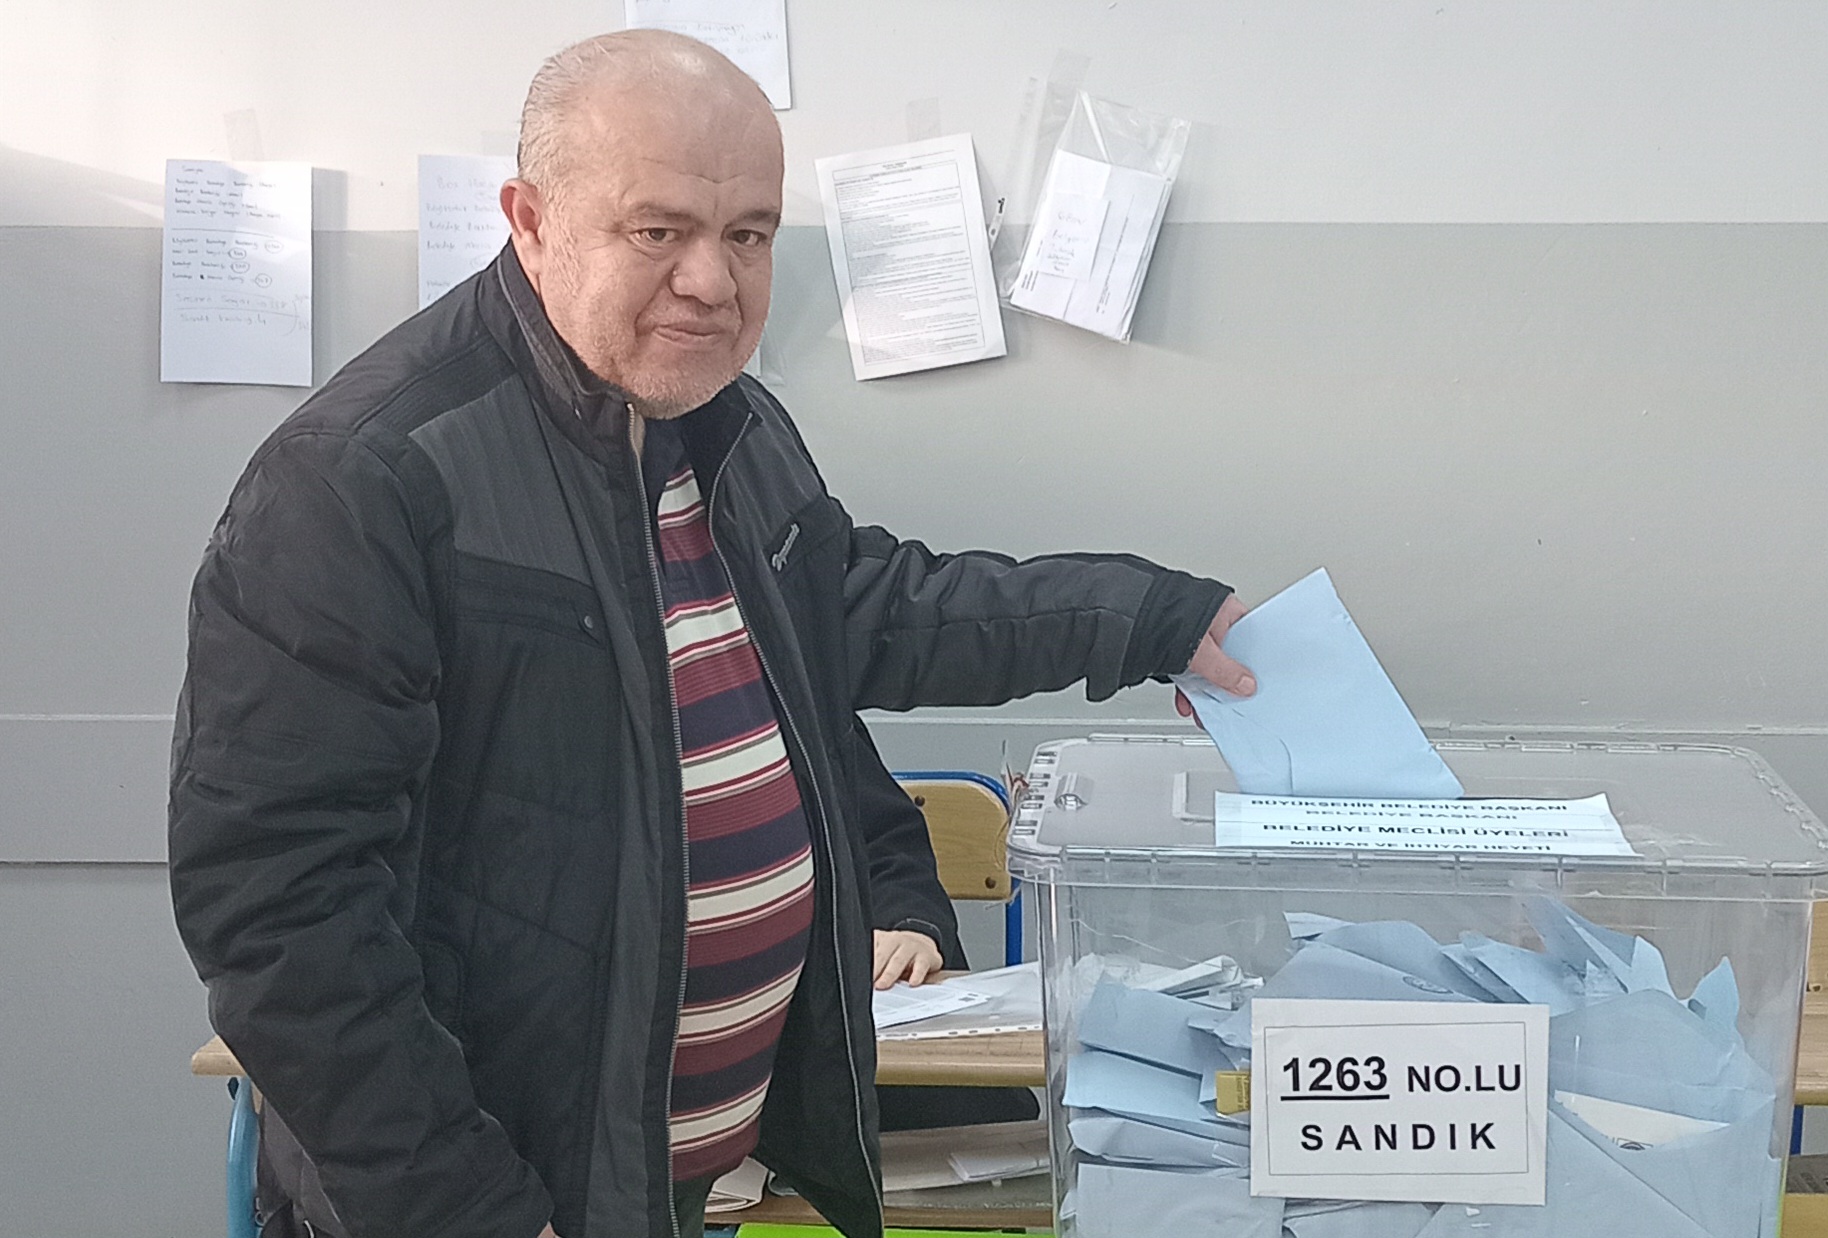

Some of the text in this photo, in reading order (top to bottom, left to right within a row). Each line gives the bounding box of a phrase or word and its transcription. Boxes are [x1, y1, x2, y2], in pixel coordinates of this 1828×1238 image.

[1263, 824, 1569, 838] BELEDİYE MECLİSİ ÜYELERİ
[1282, 1055, 1522, 1093] 1263 NO.LU
[1300, 1122, 1497, 1151] SANDIK
